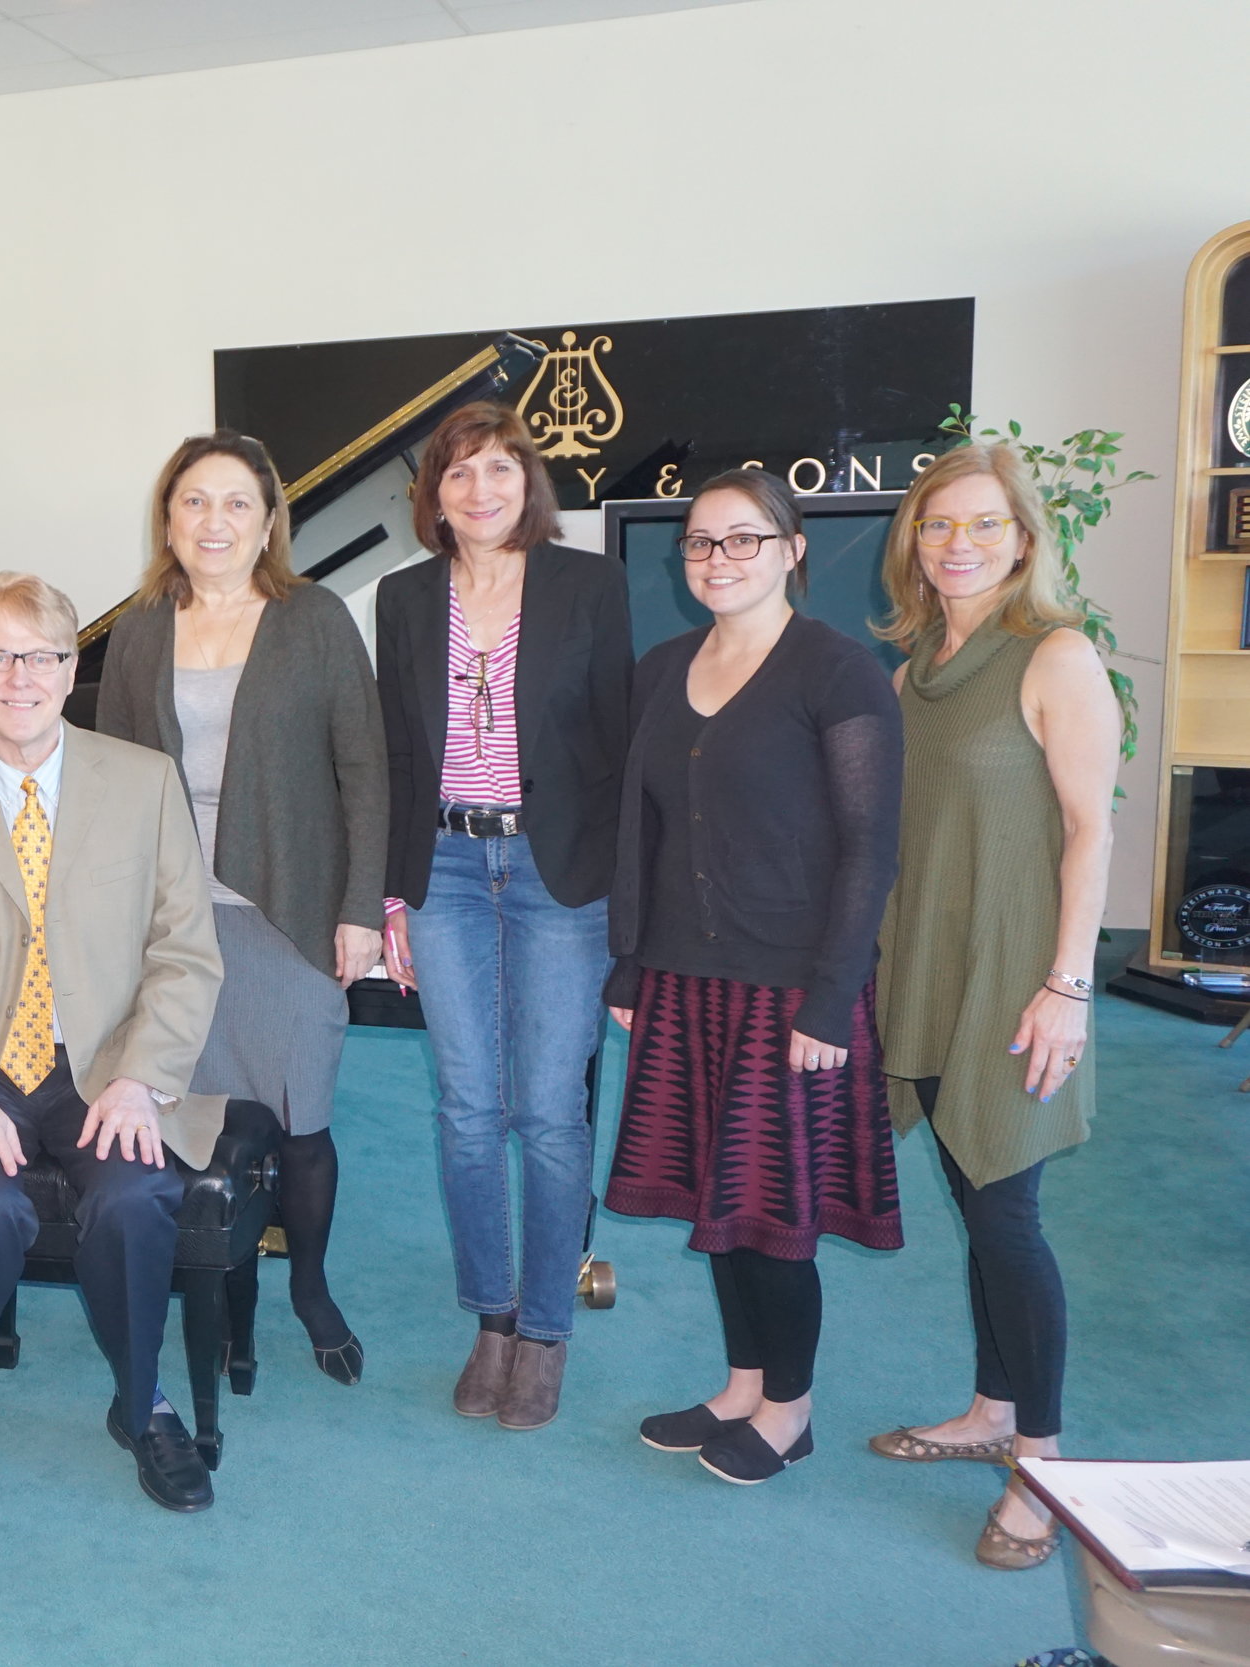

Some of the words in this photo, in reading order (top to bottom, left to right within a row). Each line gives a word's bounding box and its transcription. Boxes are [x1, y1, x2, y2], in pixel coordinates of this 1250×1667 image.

[655, 463, 683, 498] &
[740, 453, 937, 494] ONS
[1181, 889, 1229, 916] STEINWAY
[1182, 925, 1221, 947] BOSTON
